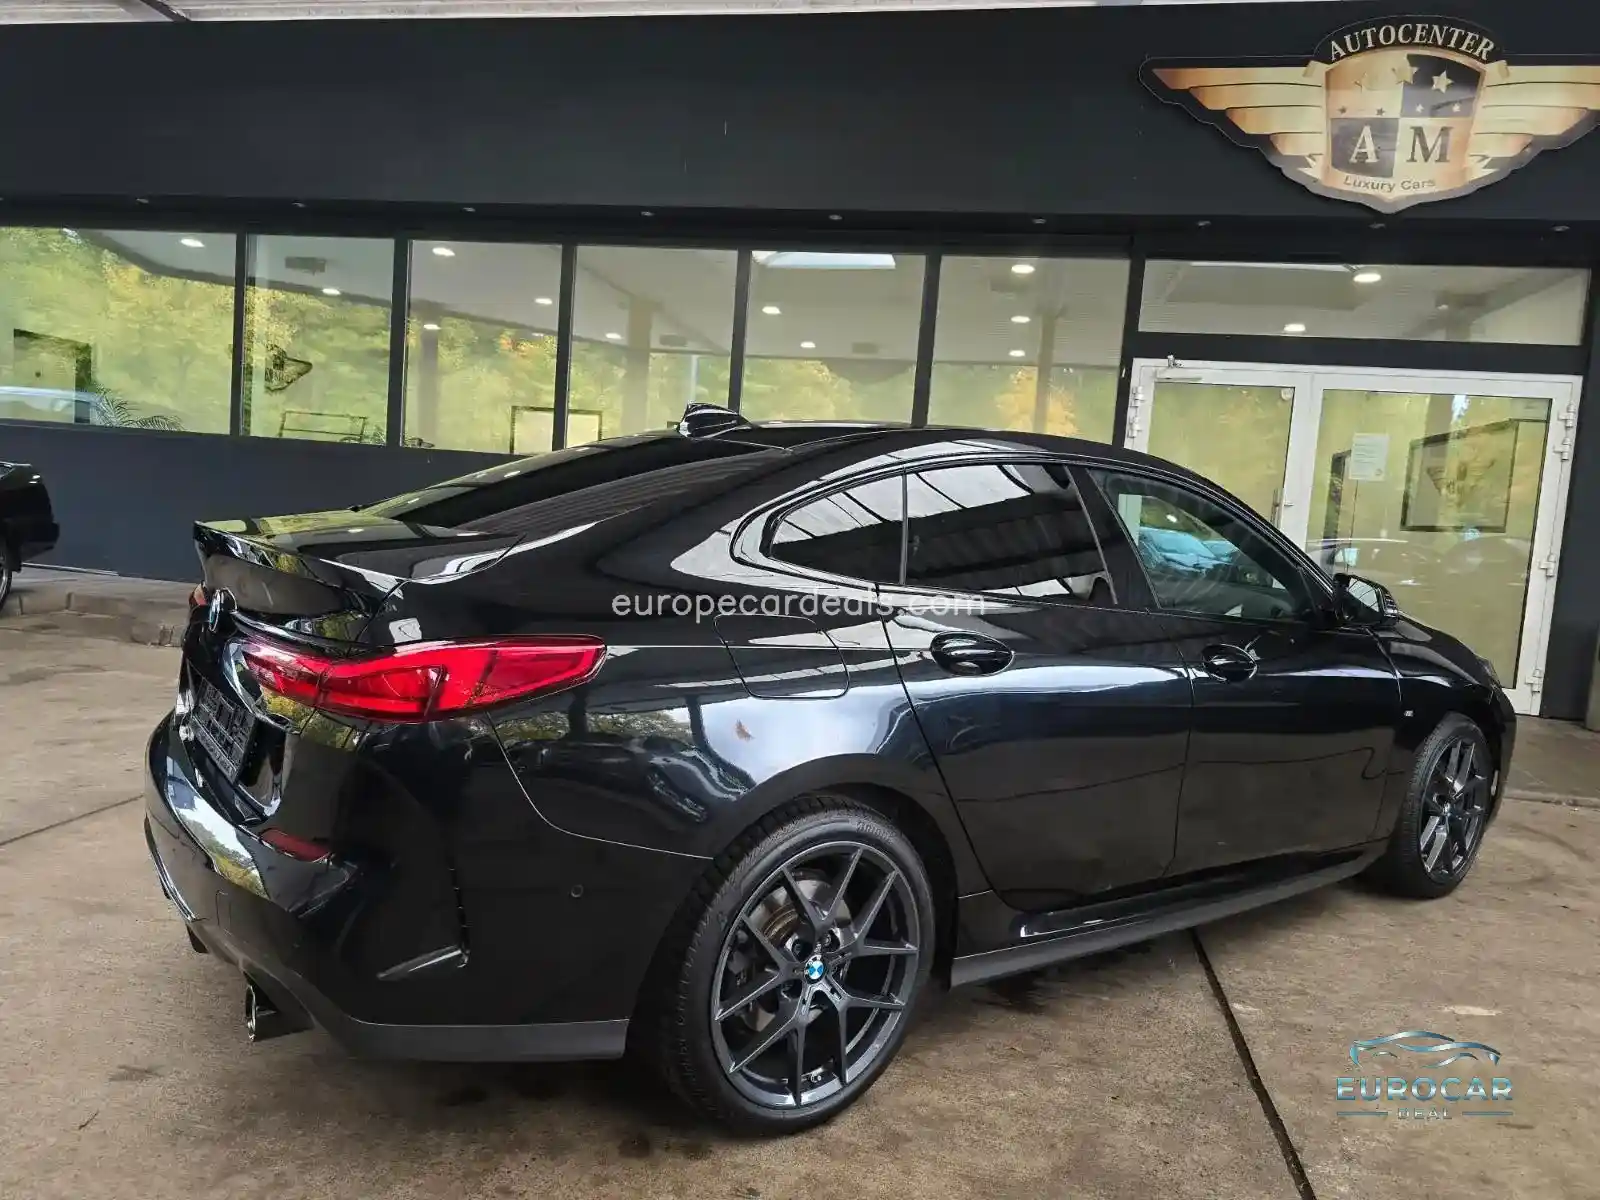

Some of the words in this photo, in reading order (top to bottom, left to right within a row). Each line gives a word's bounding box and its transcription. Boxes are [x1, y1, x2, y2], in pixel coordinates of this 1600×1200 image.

[1330, 23, 1495, 62] AUTOCENTER
[1350, 125, 1380, 163] A
[1406, 126, 1453, 163] M
[1343, 174, 1396, 193] Luxury
[1400, 178, 1436, 191] Cars
